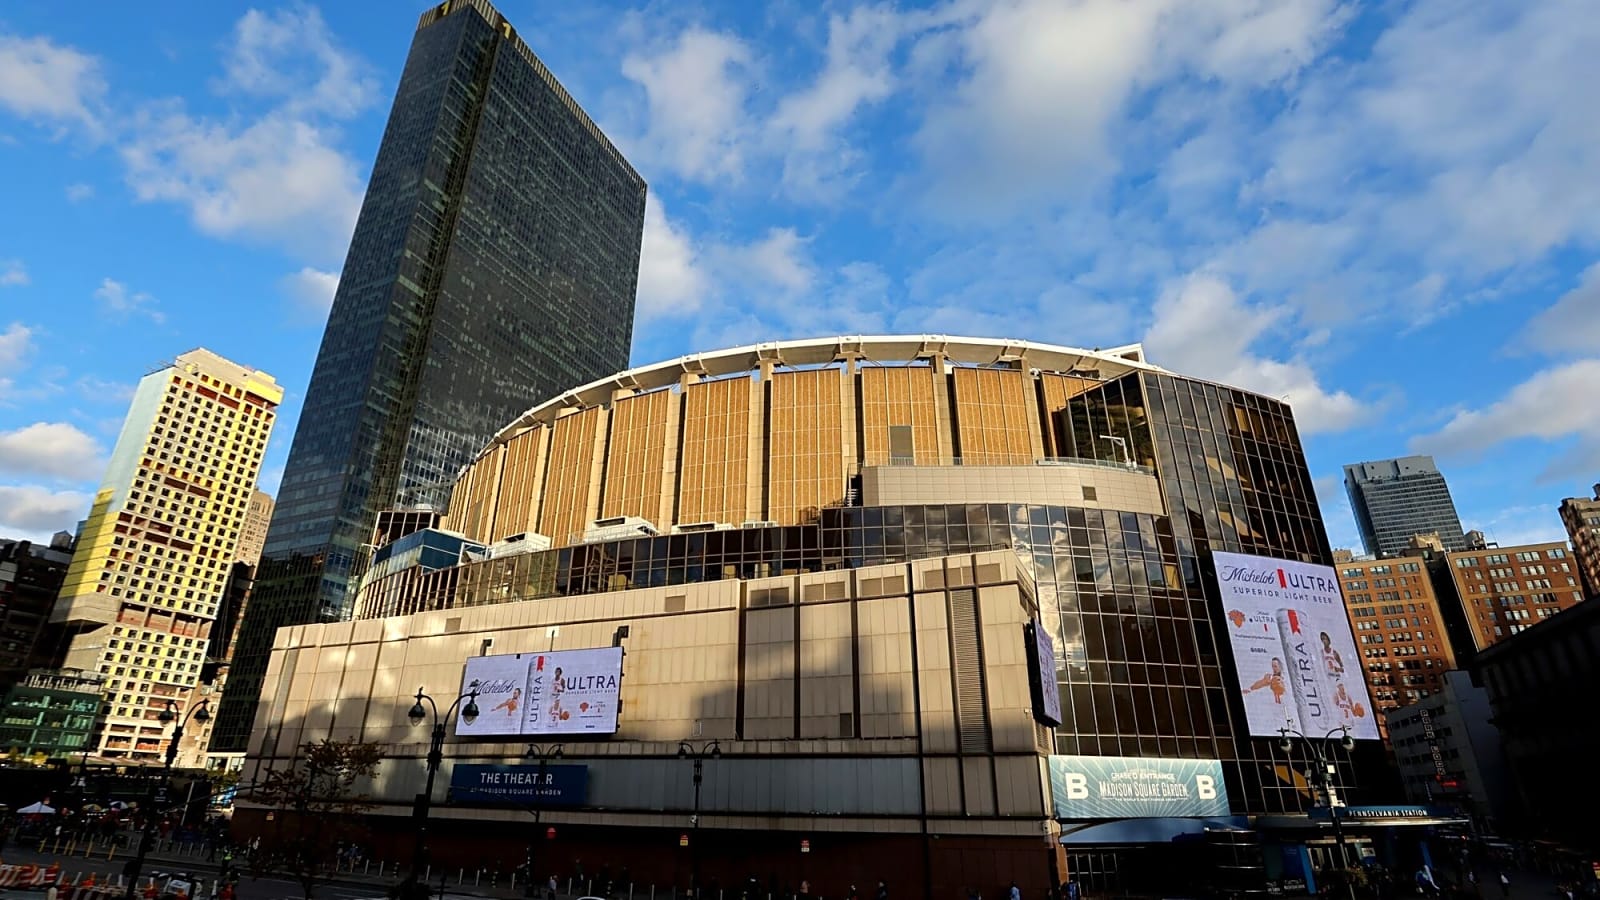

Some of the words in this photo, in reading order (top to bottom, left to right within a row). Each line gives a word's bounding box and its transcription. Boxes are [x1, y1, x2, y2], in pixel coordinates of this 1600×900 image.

[441, 1, 450, 15] 1
[502, 22, 511, 39] 1
[1221, 566, 1274, 584] Michelob
[1288, 573, 1337, 593] ULTRA
[1233, 587, 1280, 597] SUPERIOR
[1284, 592, 1309, 601] LIGHT
[1313, 596, 1332, 604] BEER
[566, 675, 617, 690] ULTRA
[1295, 642, 1321, 717] ULTRA
[529, 676, 543, 723] ULTRA
[480, 772, 501, 784] THE
[503, 773, 553, 785] THEATR
[1064, 772, 1089, 800] B
[1195, 774, 1217, 800] B
[1099, 781, 1133, 797] MADISON
[1134, 781, 1161, 798] SQUARE
[1161, 781, 1188, 797] GARDEN
[1348, 809, 1400, 817] PENNSYLVANIA
[1400, 809, 1428, 817] STATION
